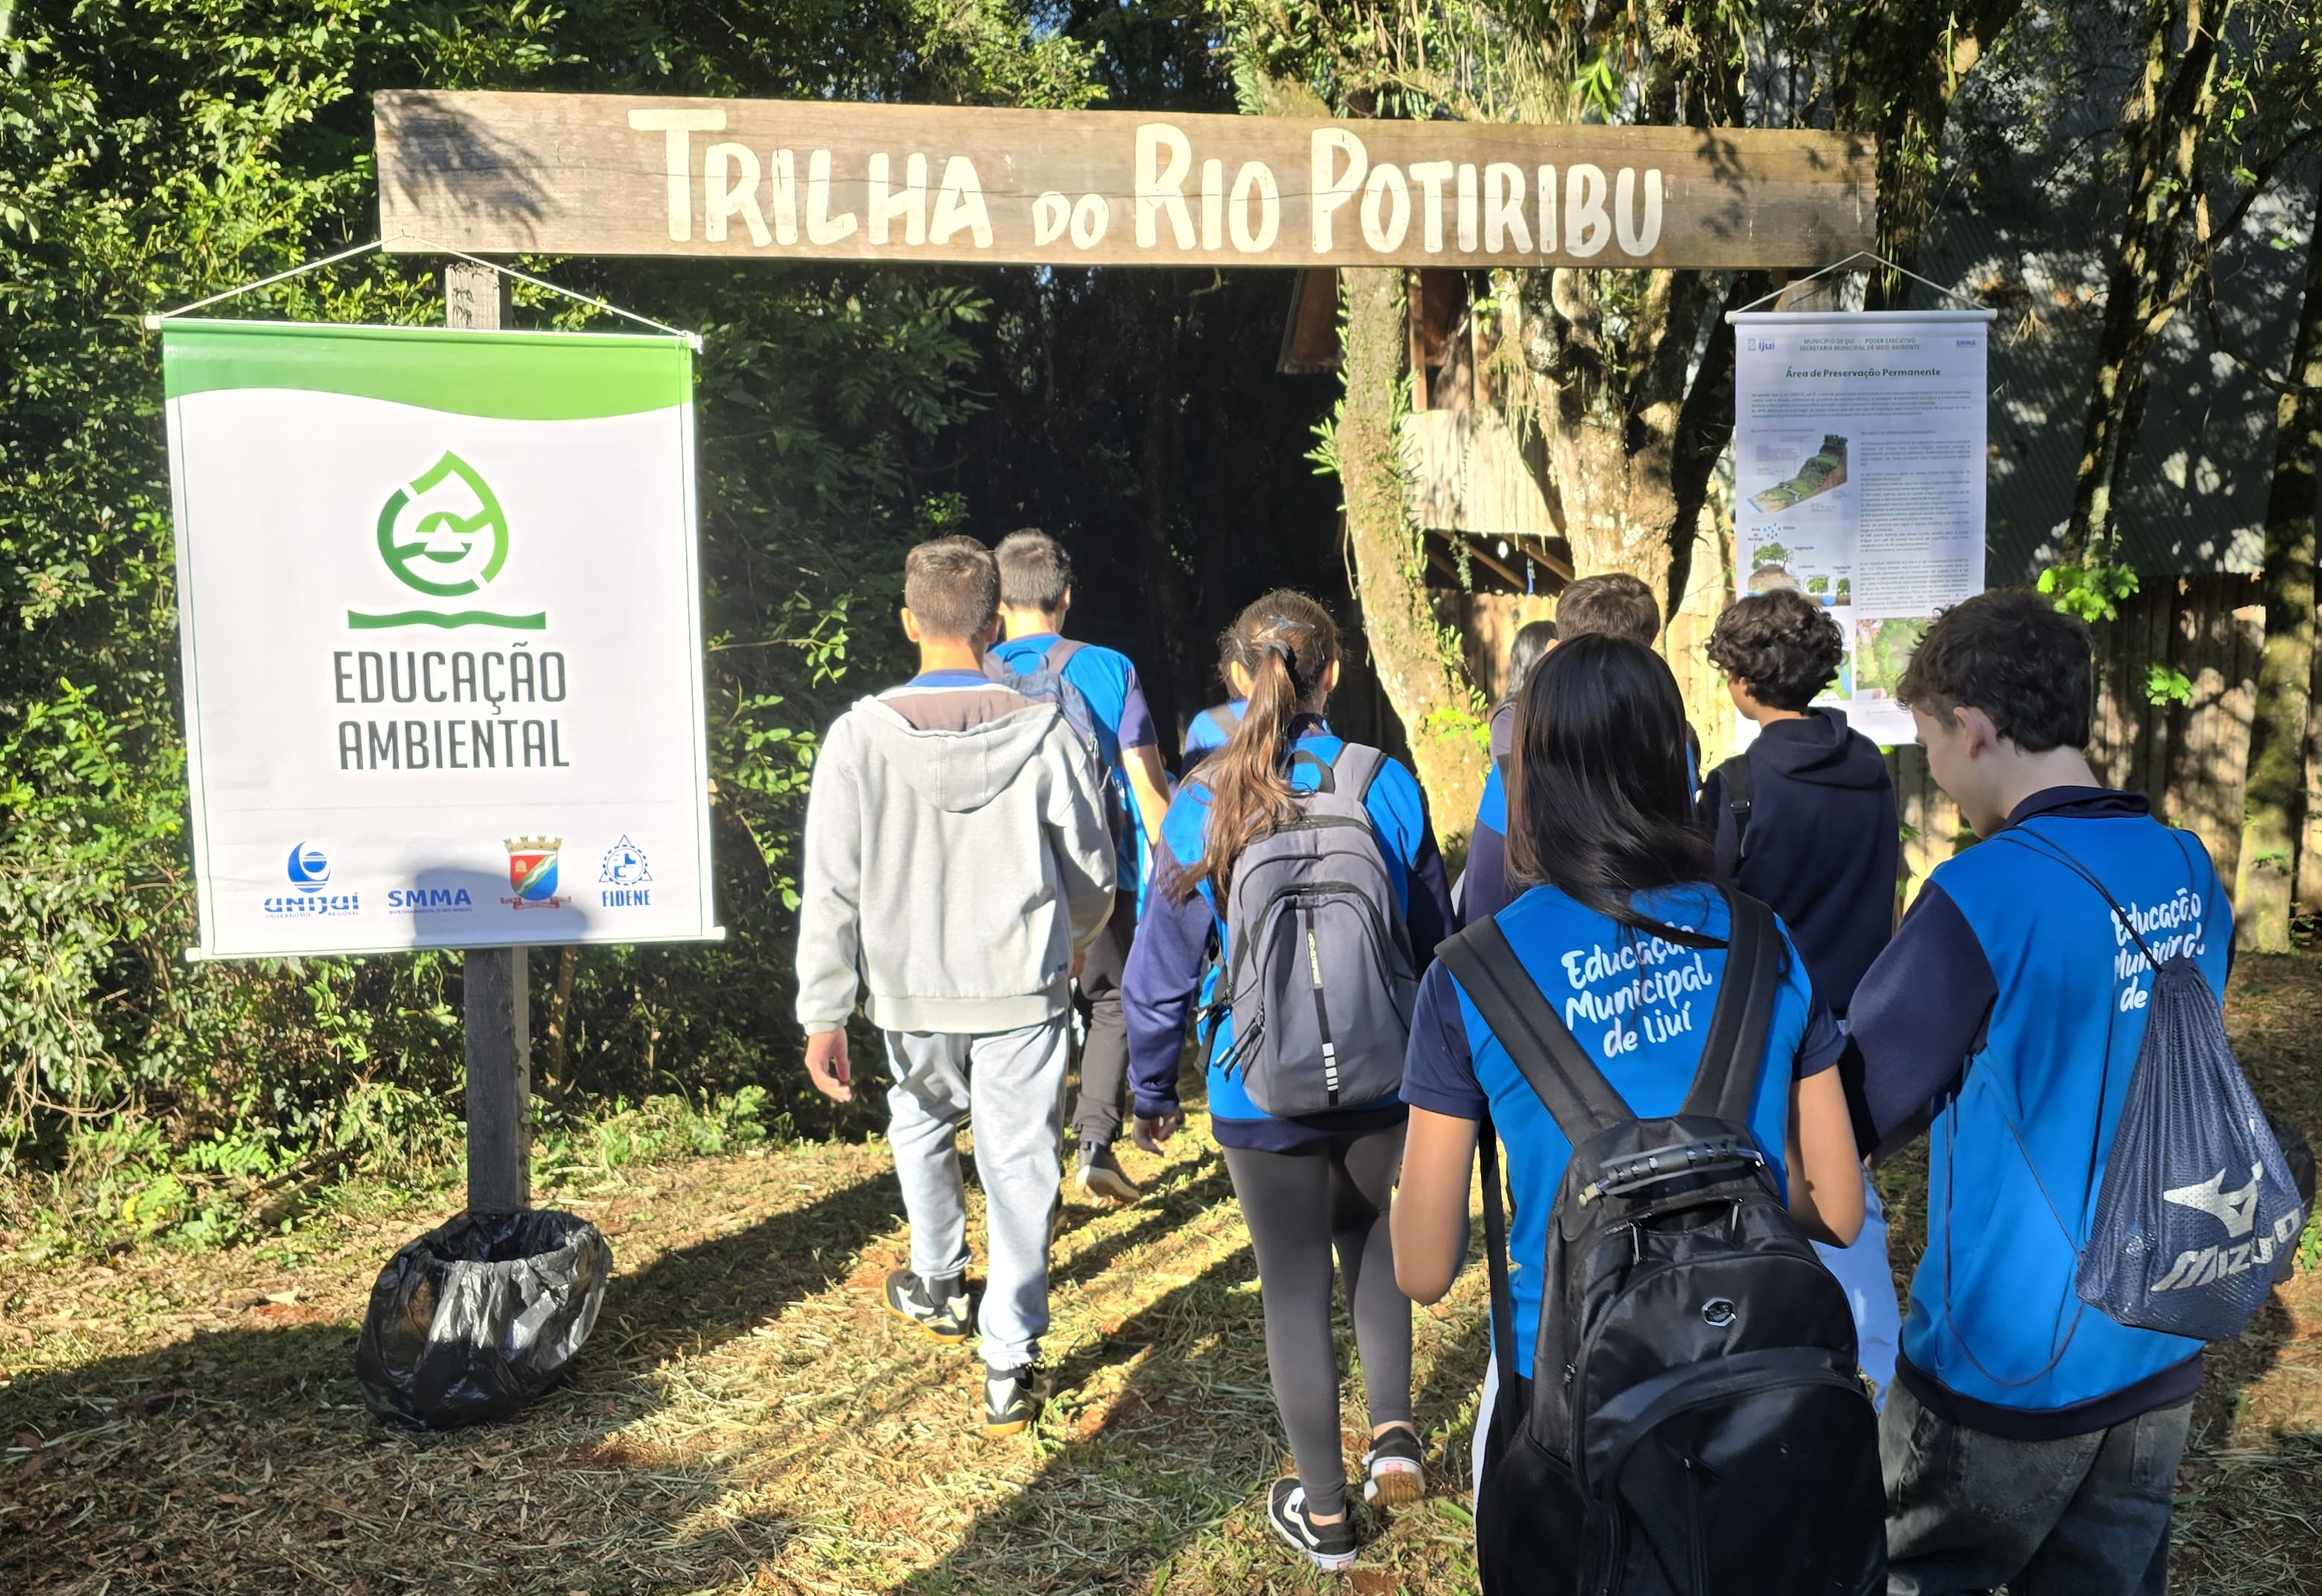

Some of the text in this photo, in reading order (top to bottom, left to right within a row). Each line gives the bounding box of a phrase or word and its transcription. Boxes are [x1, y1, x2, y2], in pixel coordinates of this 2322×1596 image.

[627, 109, 1663, 258] TRILHA DO RIO POTIRIBU
[1786, 365, 1941, 379] Área de Preservação Permanente
[333, 641, 566, 716] EDUCAÇÃO
[339, 719, 570, 770] AMBIENTAL
[388, 888, 473, 908] SMMA
[601, 889, 651, 907] FIDENE
[1565, 952, 1712, 1031] Municipal
[2120, 975, 2148, 1013] de
[1603, 1001, 1692, 1058] de Ijuí
[2150, 1207, 2301, 1292] MIZUO
